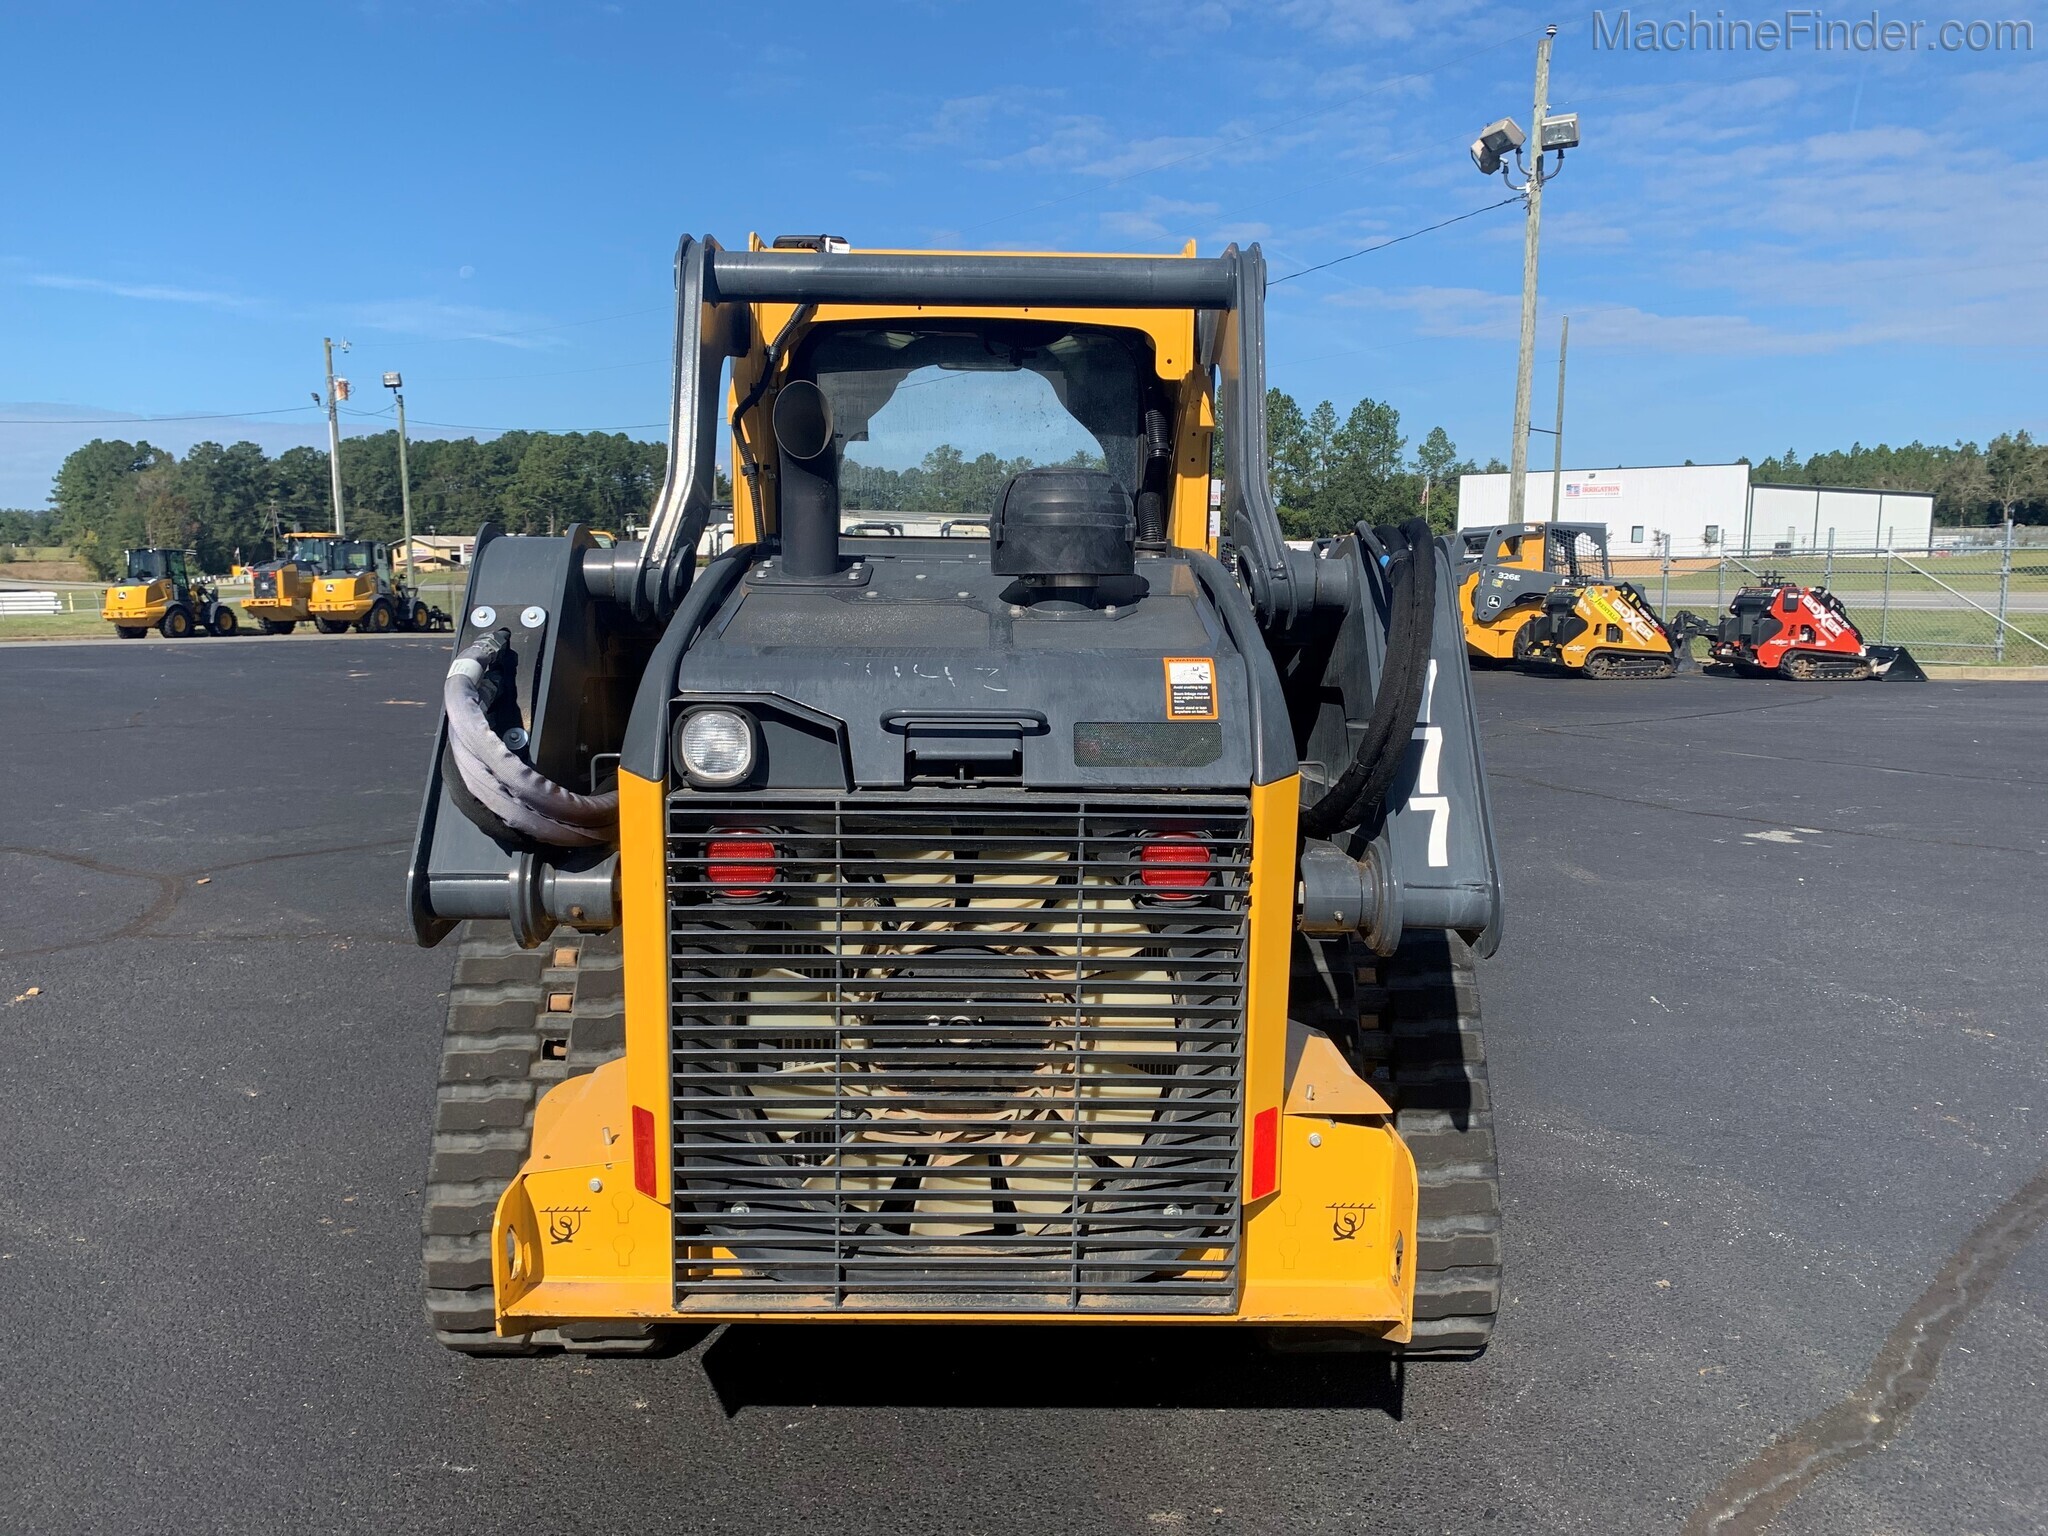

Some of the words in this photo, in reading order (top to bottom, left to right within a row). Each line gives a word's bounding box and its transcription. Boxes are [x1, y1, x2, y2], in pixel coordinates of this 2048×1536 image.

[1498, 571, 1521, 582] 326E
[1611, 598, 1655, 641] BOXER
[1802, 594, 1844, 637] BOXER
